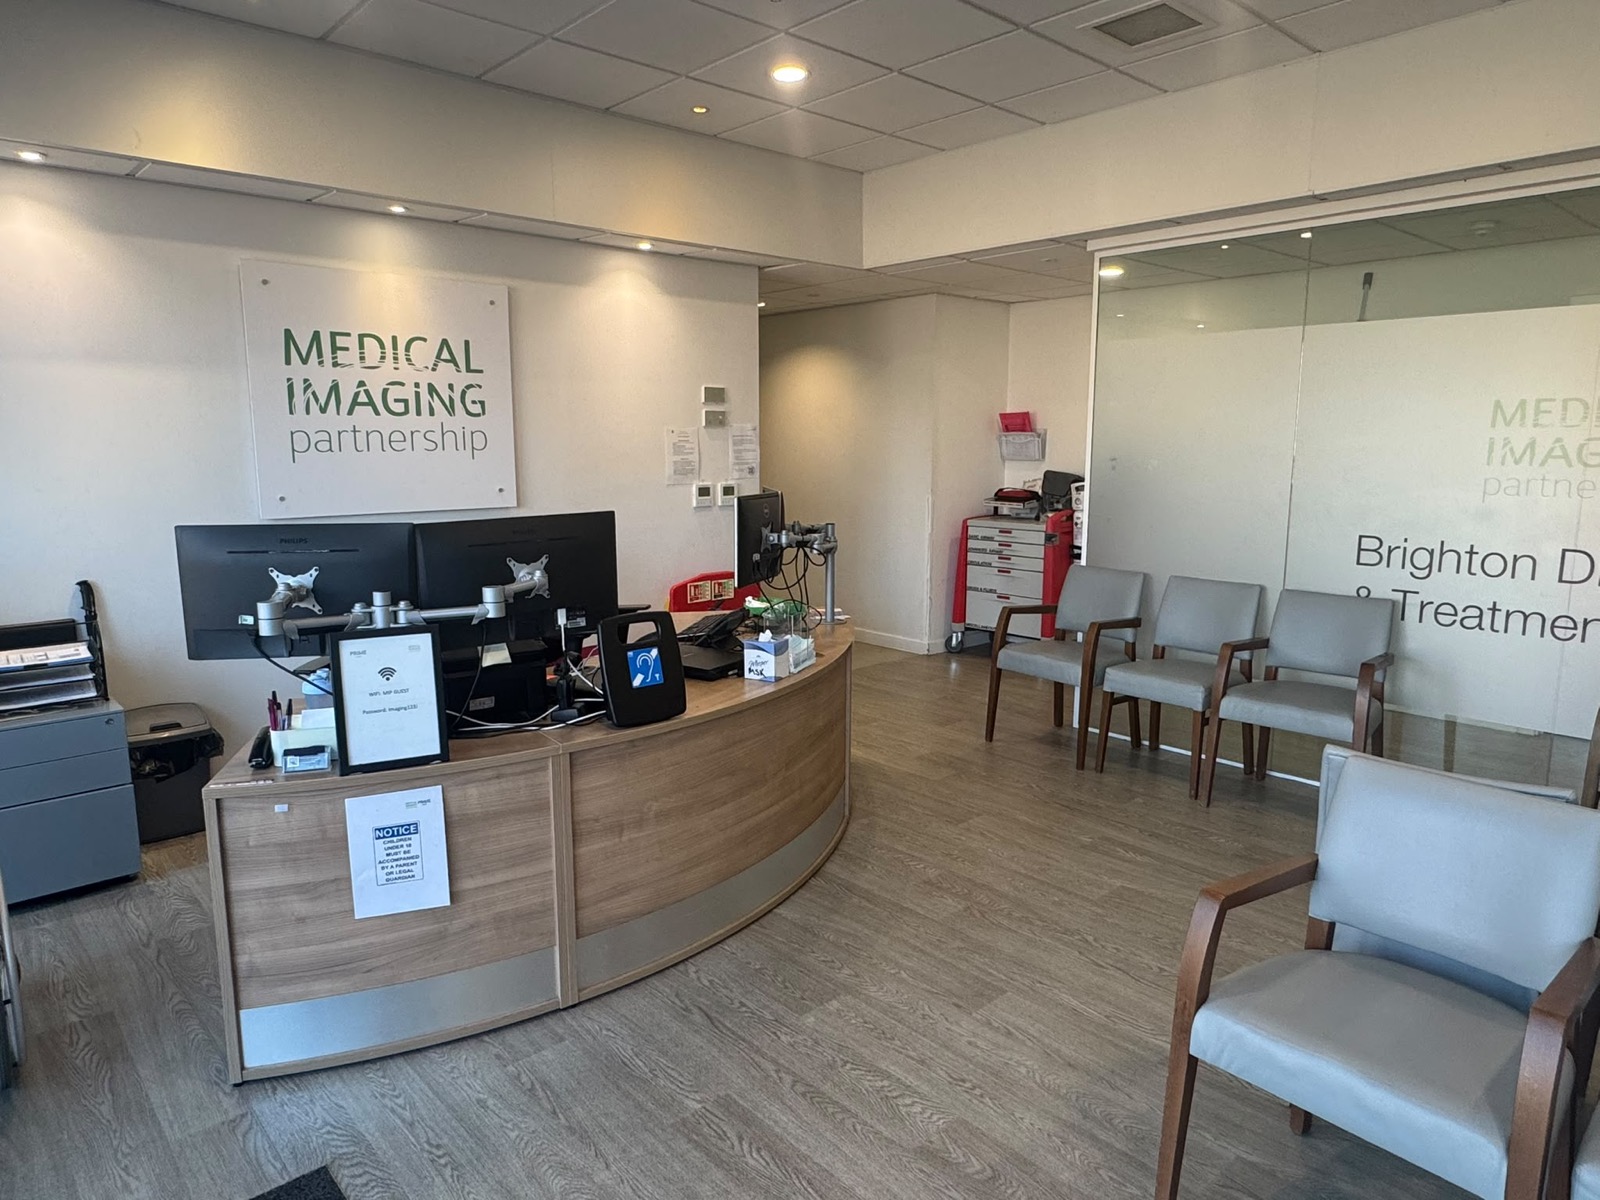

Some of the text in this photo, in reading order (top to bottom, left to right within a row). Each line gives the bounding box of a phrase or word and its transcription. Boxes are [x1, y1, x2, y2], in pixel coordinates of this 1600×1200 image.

[283, 328, 484, 374] MEDICAL
[286, 377, 486, 418] IMAGING
[290, 421, 488, 463] partnership
[1486, 435, 1600, 469] IMAG
[1482, 473, 1597, 503] partne
[1355, 534, 1600, 587] Brighton D
[375, 824, 418, 839] NOTICE
[382, 836, 412, 845] CHILDREN
[383, 843, 404, 851] UNDER
[378, 854, 420, 865] ACCOMPANIED
[395, 860, 418, 868] PARENT
[385, 874, 416, 882] GUARDIAN
